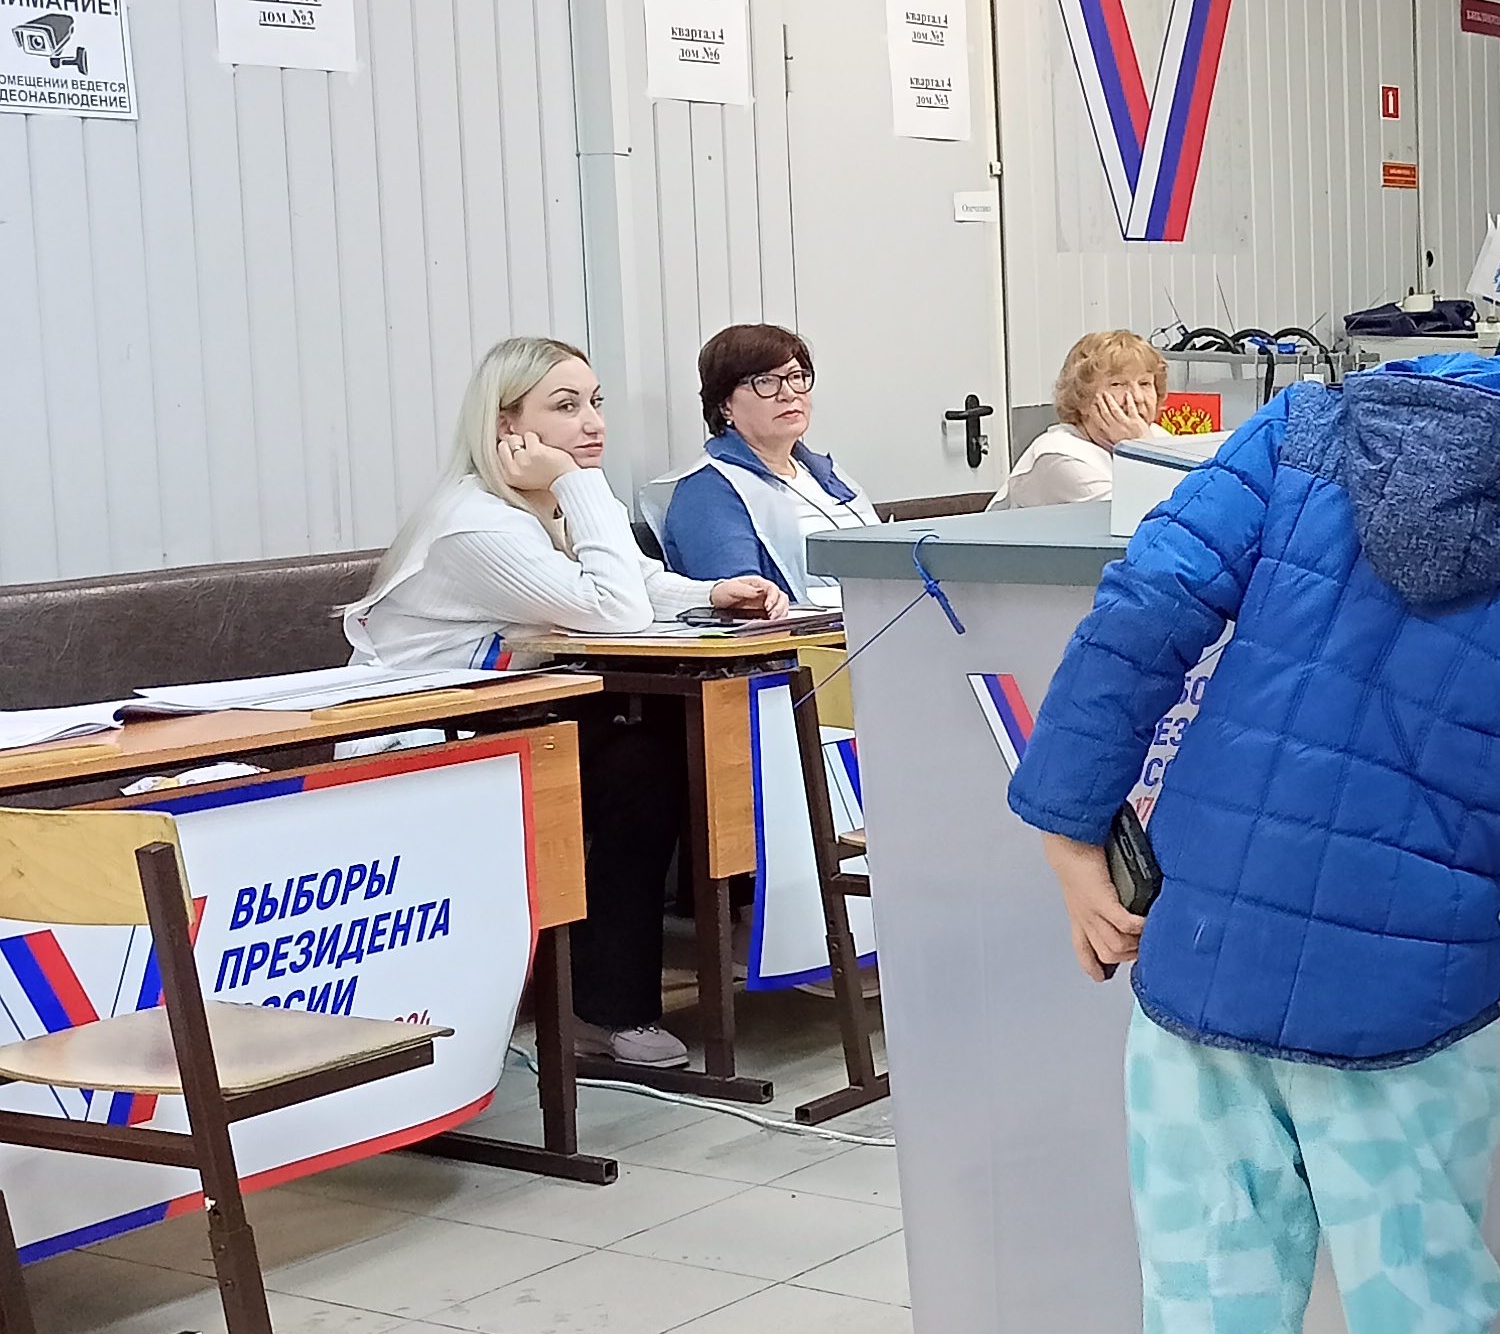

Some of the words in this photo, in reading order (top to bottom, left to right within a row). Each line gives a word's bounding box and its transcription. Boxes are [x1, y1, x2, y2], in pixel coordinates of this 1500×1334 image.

[259, 9, 287, 25] дом
[290, 9, 315, 25] №3
[671, 26, 716, 41] квартал
[718, 28, 725, 41] 4
[679, 48, 699, 61] дом
[702, 46, 720, 62] №6
[71, 79, 126, 93] ВЕДЕТСЯ
[229, 855, 401, 931] ВЫБОРЫ
[214, 897, 451, 993] ПРЕЗИДЕНТА
